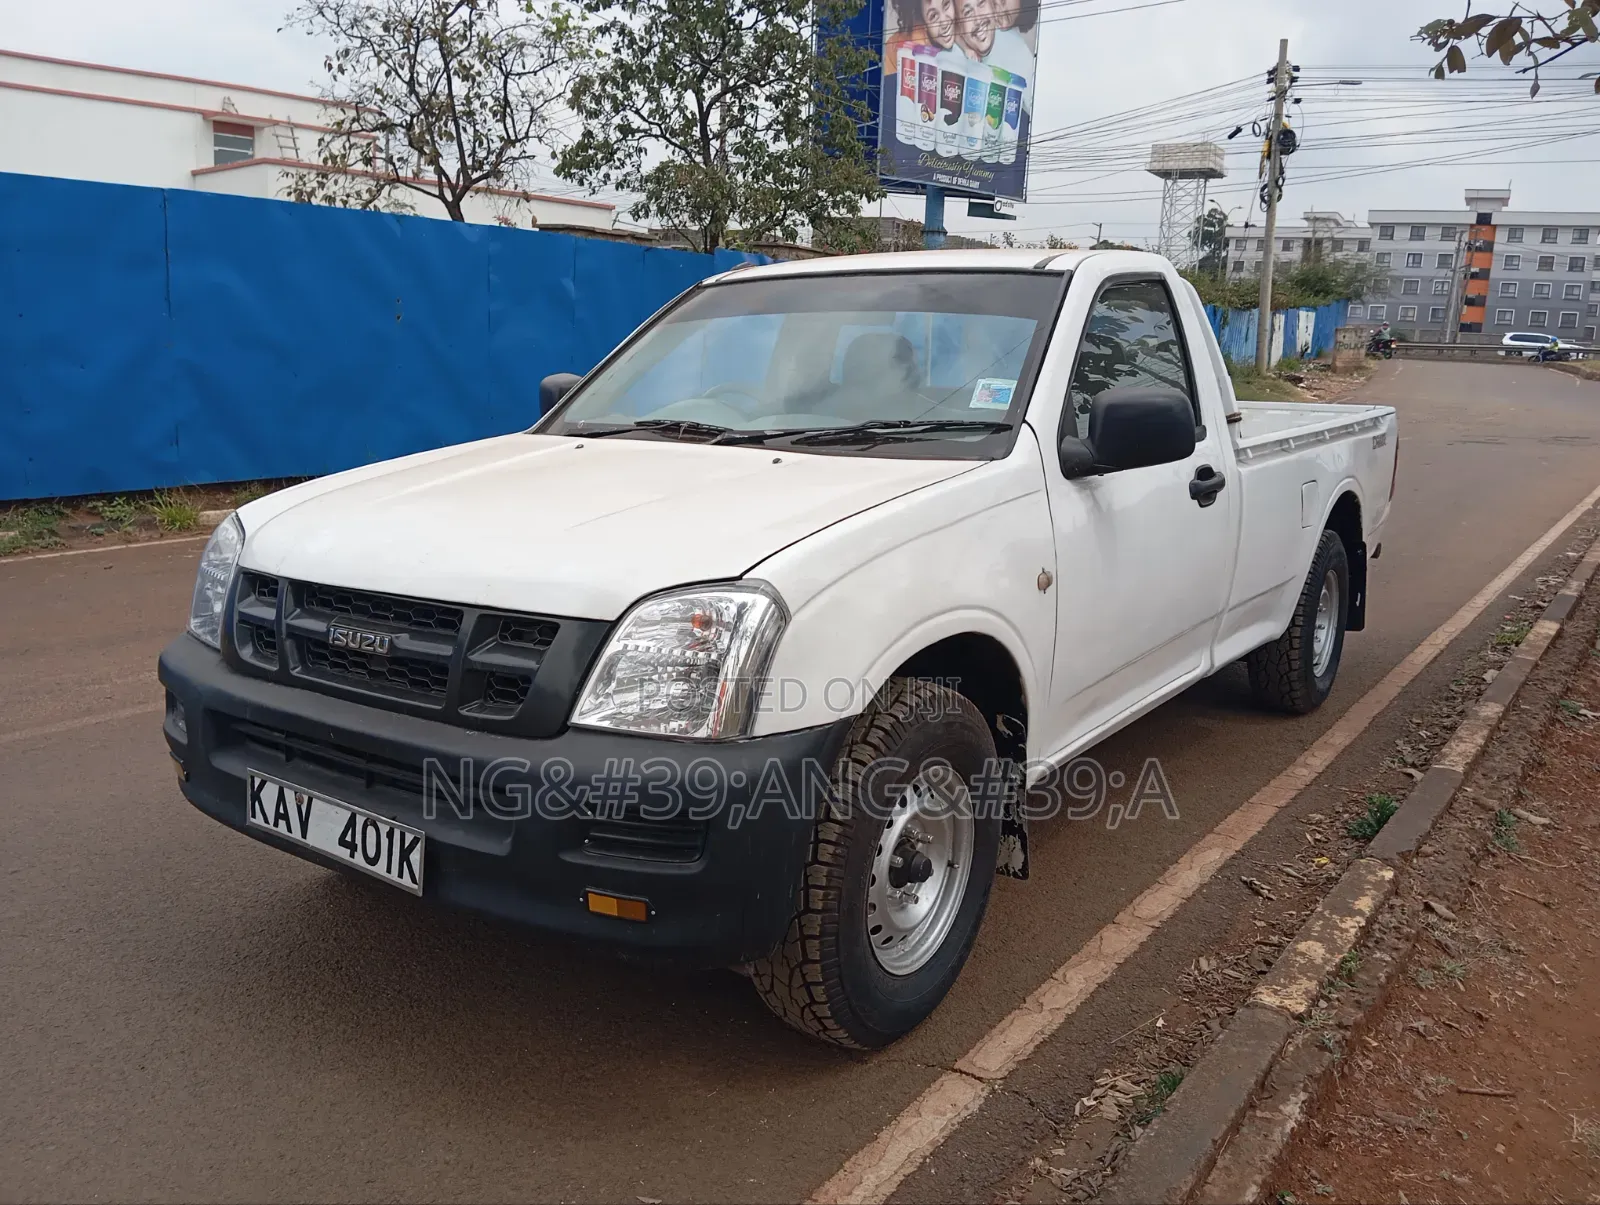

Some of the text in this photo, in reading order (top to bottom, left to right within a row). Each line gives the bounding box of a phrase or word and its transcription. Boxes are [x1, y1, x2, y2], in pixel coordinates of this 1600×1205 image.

[328, 627, 391, 654] ISUZU
[250, 775, 421, 886] KAV 401K
